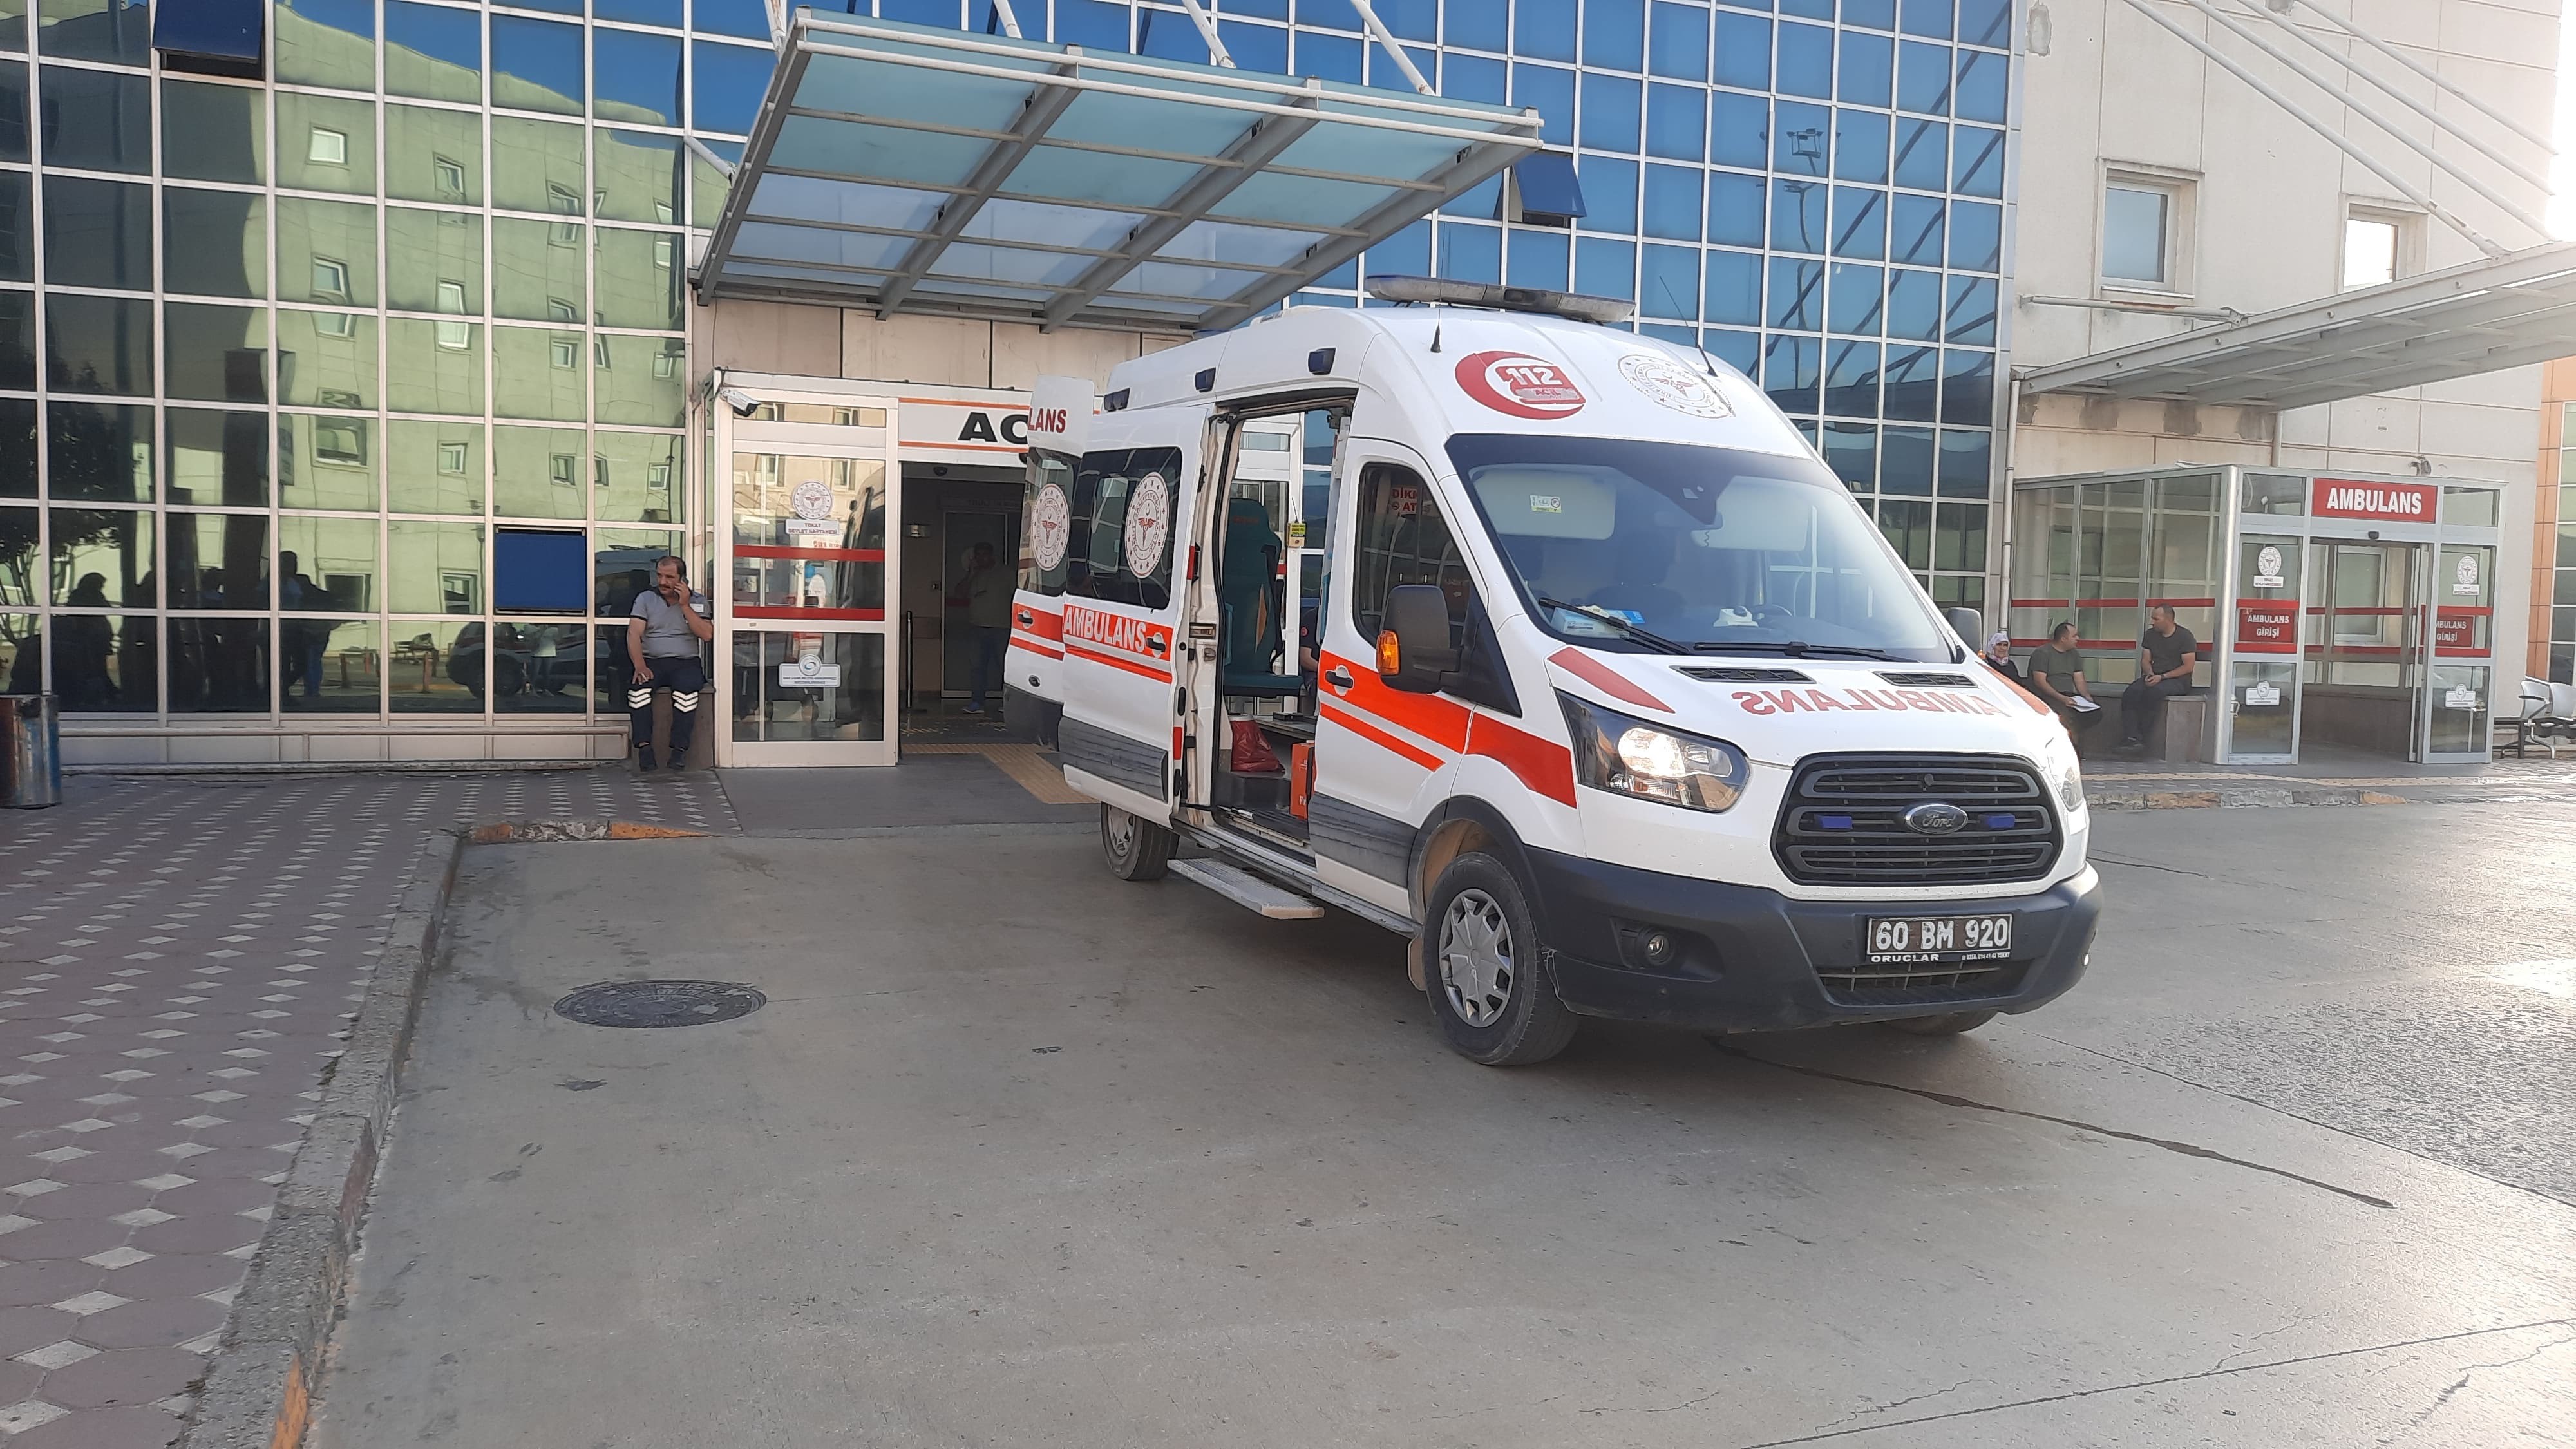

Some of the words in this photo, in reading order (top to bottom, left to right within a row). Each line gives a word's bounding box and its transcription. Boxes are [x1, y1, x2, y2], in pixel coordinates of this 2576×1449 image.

[1506, 367, 1563, 385] 112
[1028, 408, 1066, 433] LANS
[2327, 487, 2421, 514] AMBULANS
[1063, 606, 1146, 652] AMBULANS
[2247, 614, 2289, 624] AMBULANS
[1922, 811, 1956, 827] Ford
[1876, 922, 1909, 950] 60
[1920, 920, 1954, 950] BM
[1965, 918, 2008, 948] 920
[1871, 954, 1939, 963] ORUCLAR
